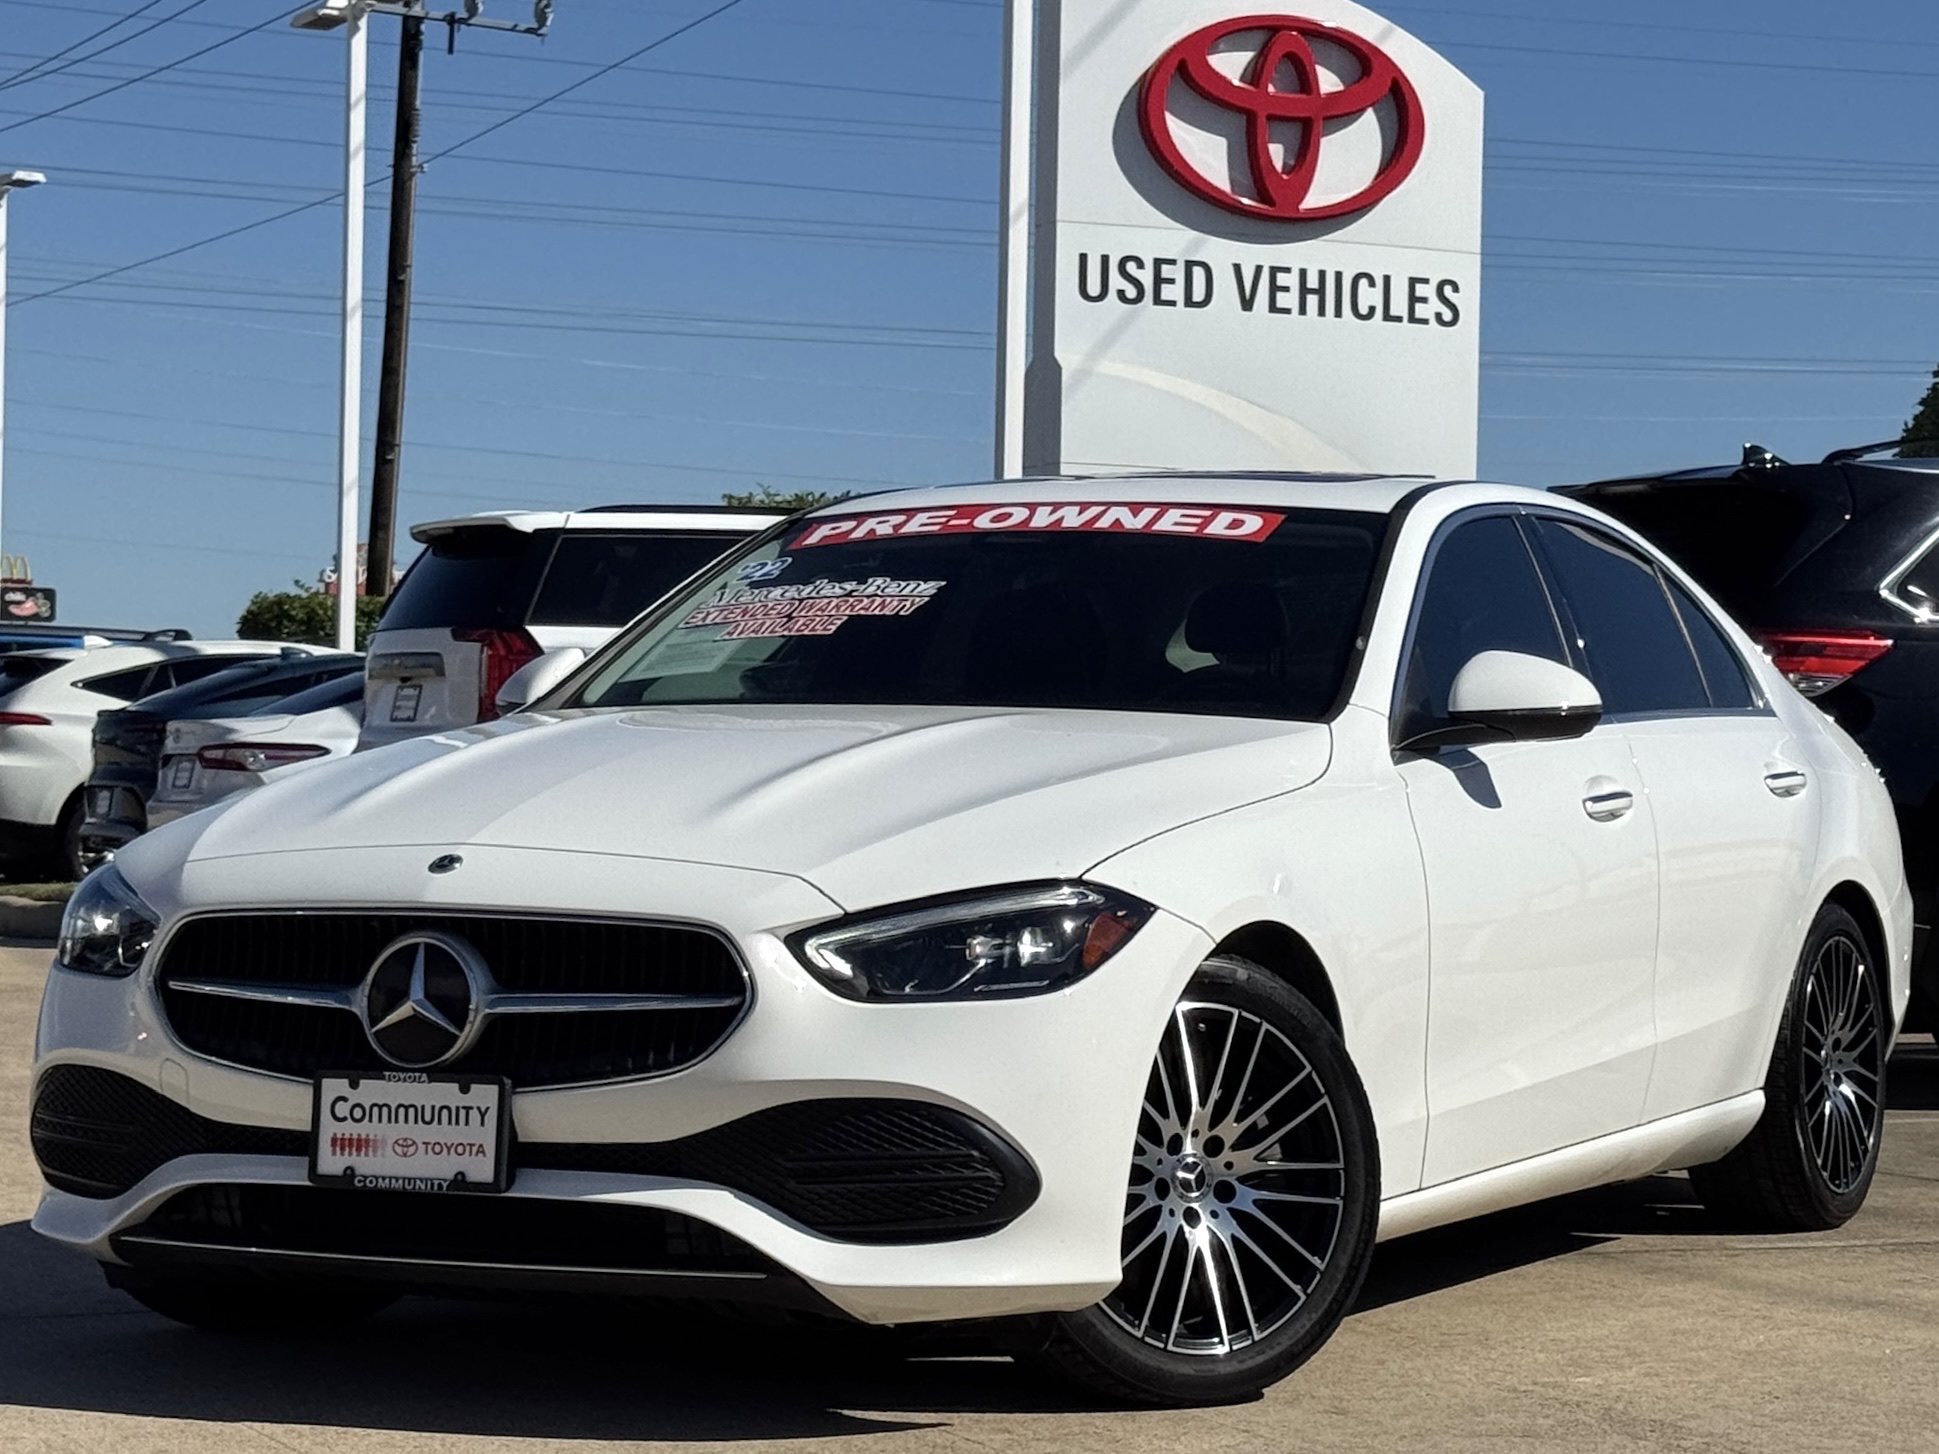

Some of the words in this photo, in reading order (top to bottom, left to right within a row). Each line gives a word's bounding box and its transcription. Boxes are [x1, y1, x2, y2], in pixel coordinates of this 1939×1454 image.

[1078, 251, 1215, 309] USED
[1232, 262, 1462, 328] VEHICLES
[803, 505, 1266, 545] PRE-OWNED
[702, 577, 946, 607] Mercedes-Benz
[684, 600, 797, 626] EXTENDED
[795, 596, 926, 616] WARRANTY
[723, 616, 845, 638] AVAILABLE
[383, 1071, 429, 1083] TOYOTA
[422, 1141, 487, 1158] TOYOTA
[354, 1176, 450, 1192] COMMUNITY
